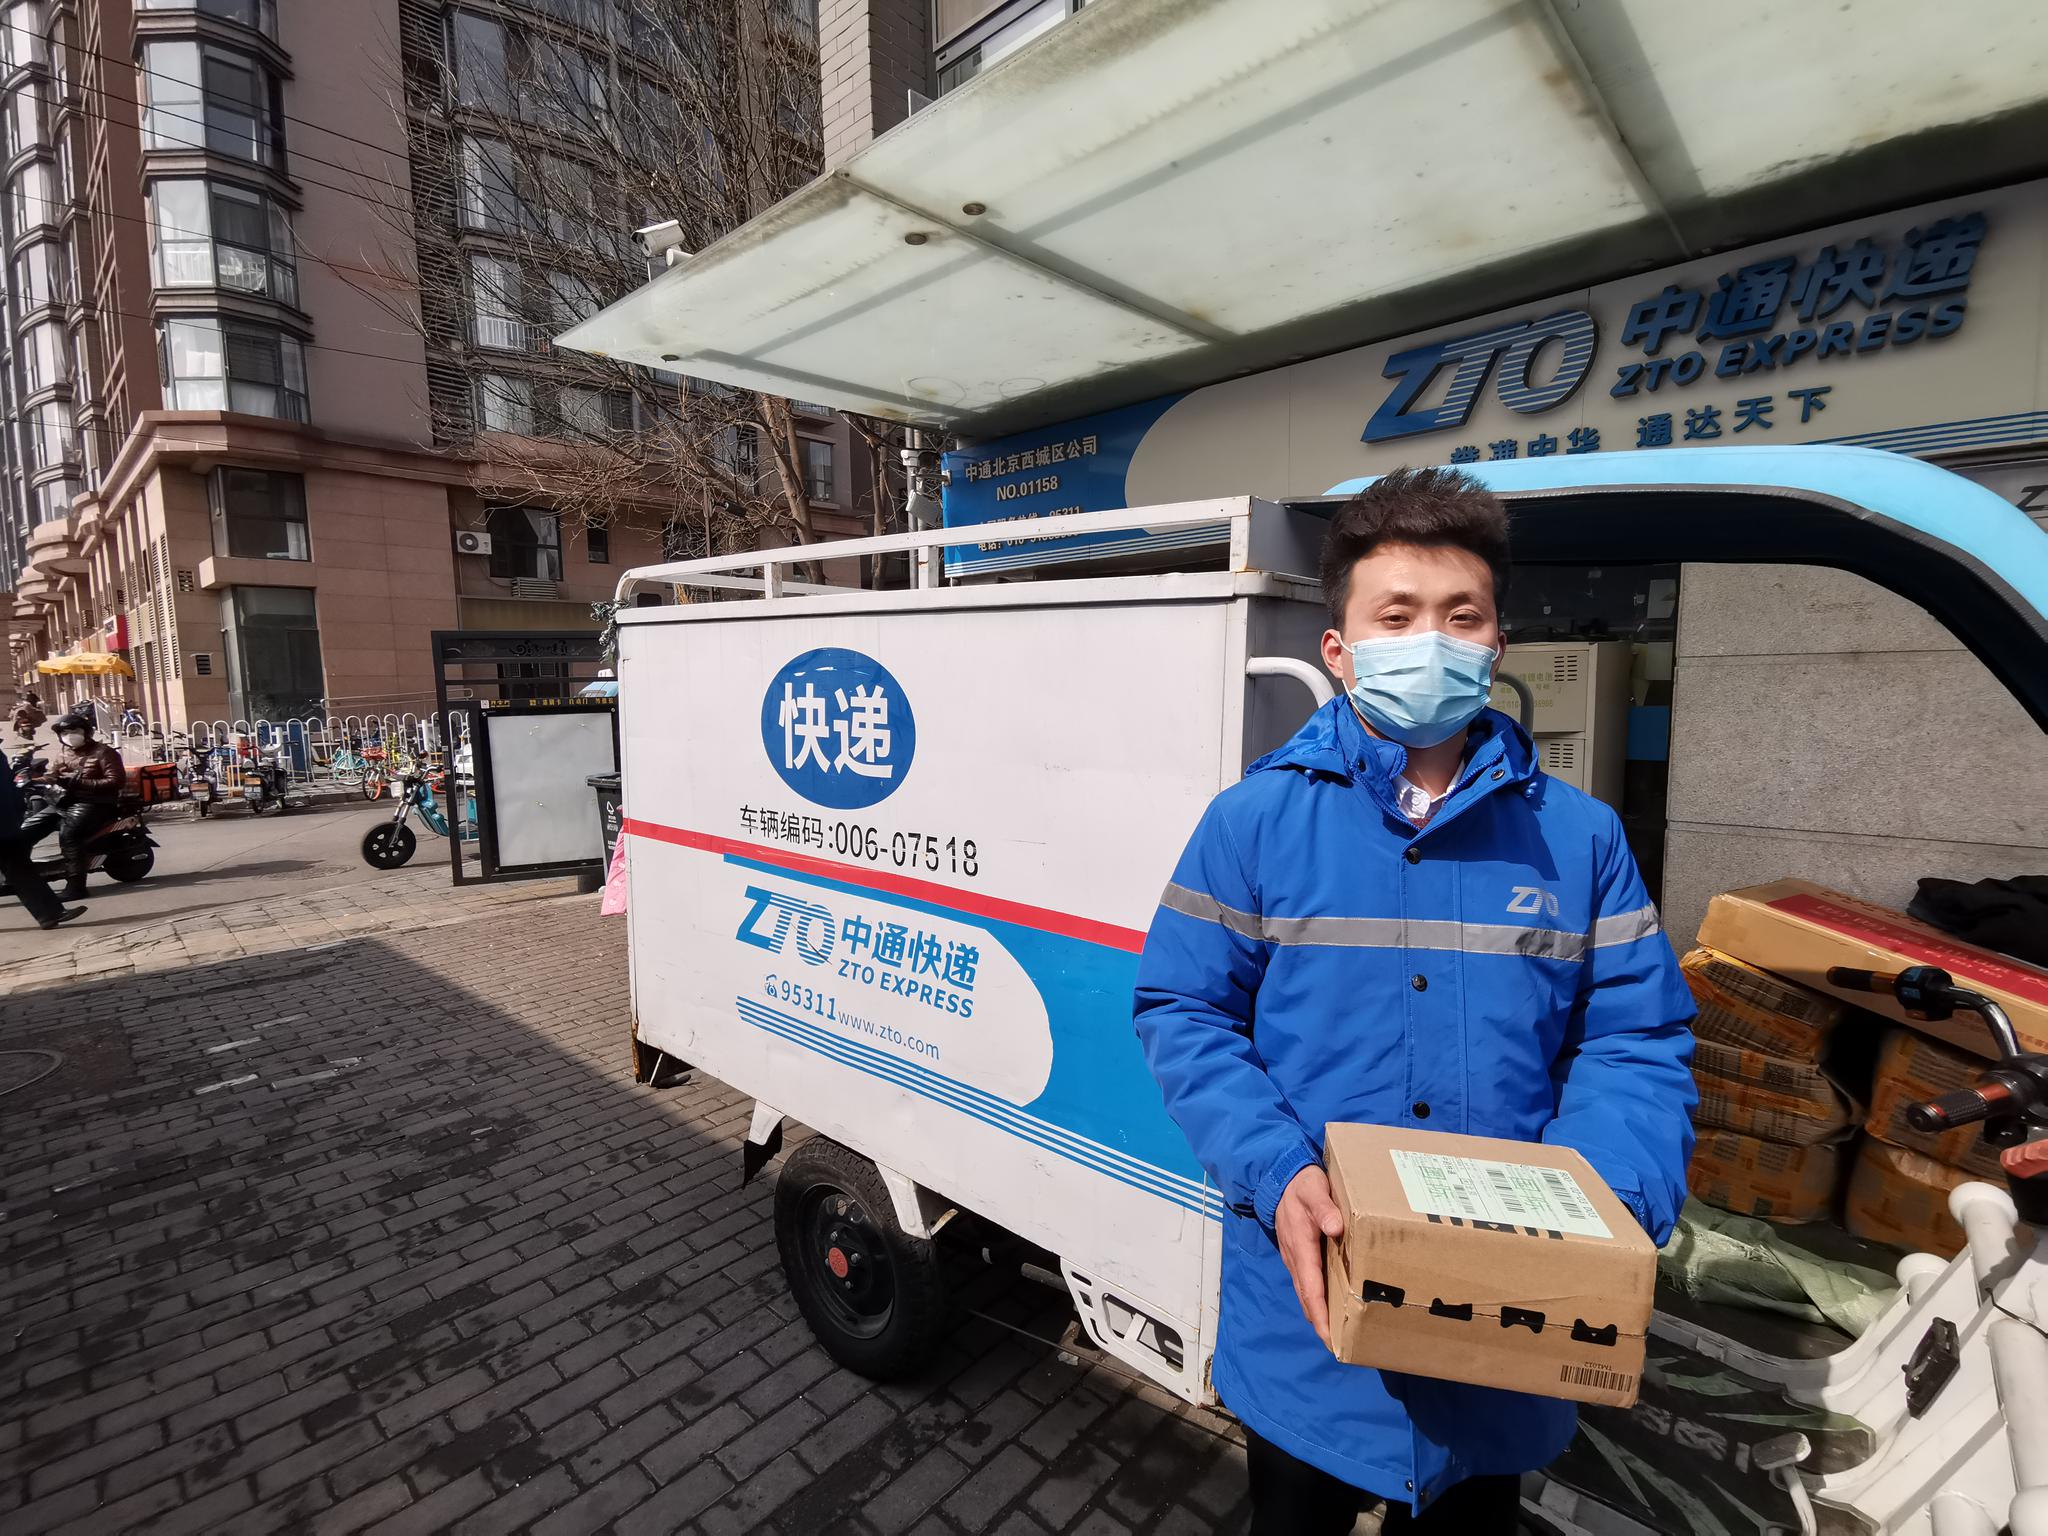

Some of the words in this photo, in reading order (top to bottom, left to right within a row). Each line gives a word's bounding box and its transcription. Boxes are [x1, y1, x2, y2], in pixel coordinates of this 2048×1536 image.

[1620, 212, 1987, 355] 中通快递
[1361, 307, 1601, 444] ZTO
[1610, 350, 1706, 398] ZTO
[1714, 300, 1968, 379] EXPRESS
[1636, 385, 1832, 448] 通达天下
[965, 435, 1097, 482] 中通北京西城区公司
[996, 475, 1059, 501] NO.01158
[779, 682, 893, 778] 快递
[736, 885, 836, 967] ZTO
[840, 915, 979, 992] 中通快递
[780, 980, 837, 1021] 95311
[838, 1010, 940, 1060] www.zto.com
[838, 959, 875, 985] ZTO
[880, 972, 975, 1019] EXPRESS
